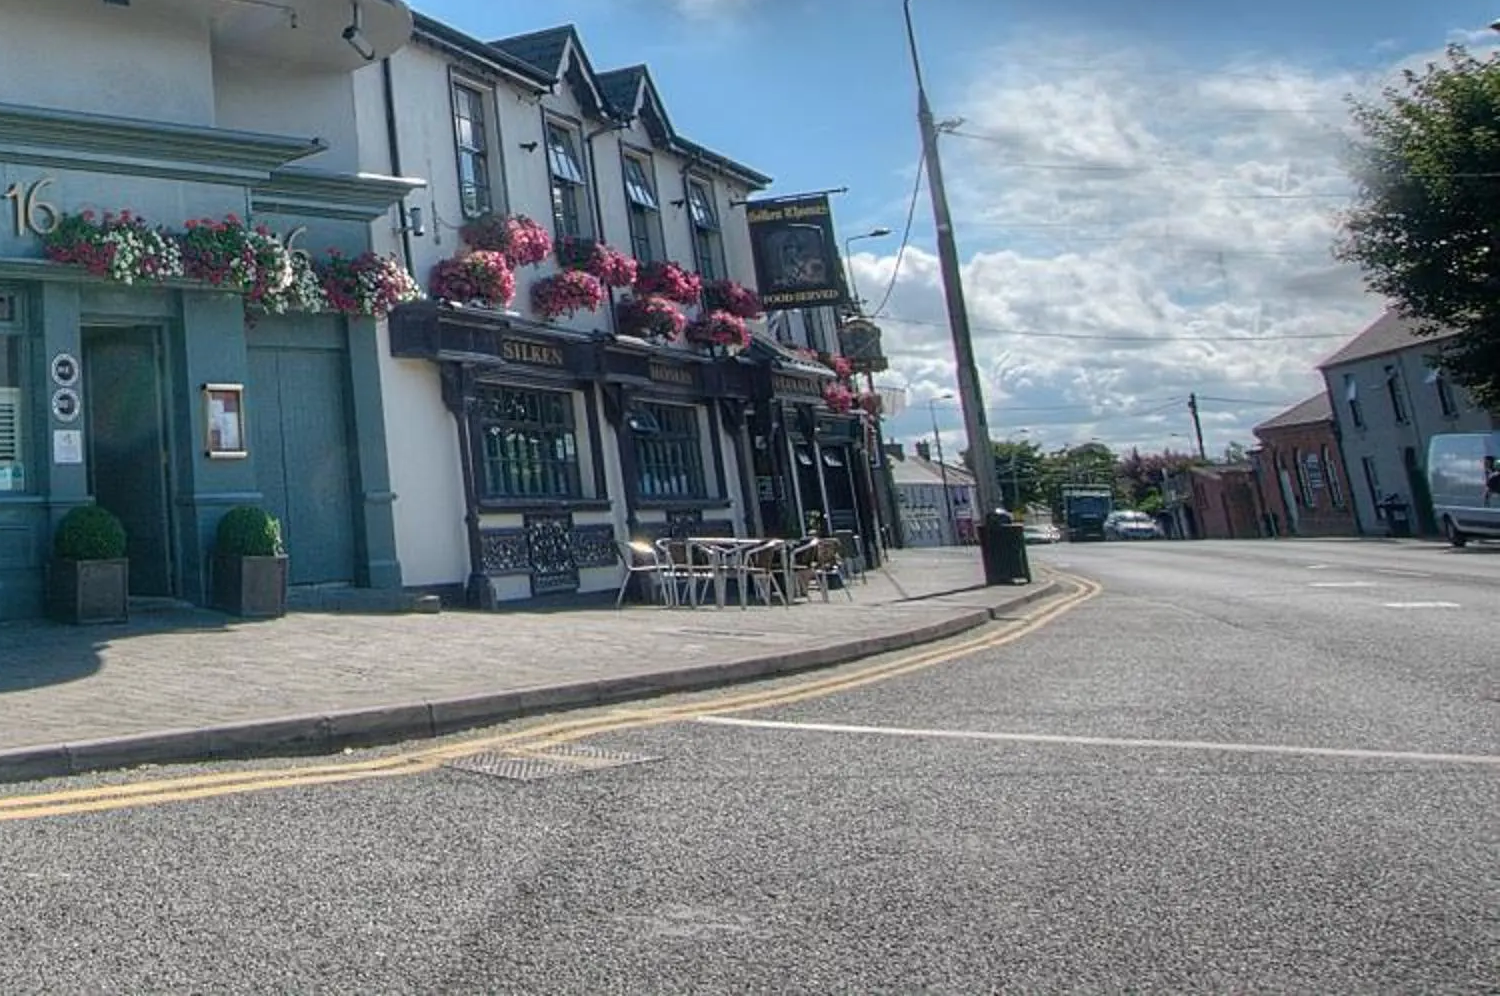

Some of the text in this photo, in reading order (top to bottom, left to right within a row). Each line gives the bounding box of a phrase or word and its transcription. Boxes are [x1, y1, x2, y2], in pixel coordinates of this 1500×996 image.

[3, 176, 60, 238] 16
[763, 293, 793, 305] FOOD
[503, 340, 563, 365] SILKEN
